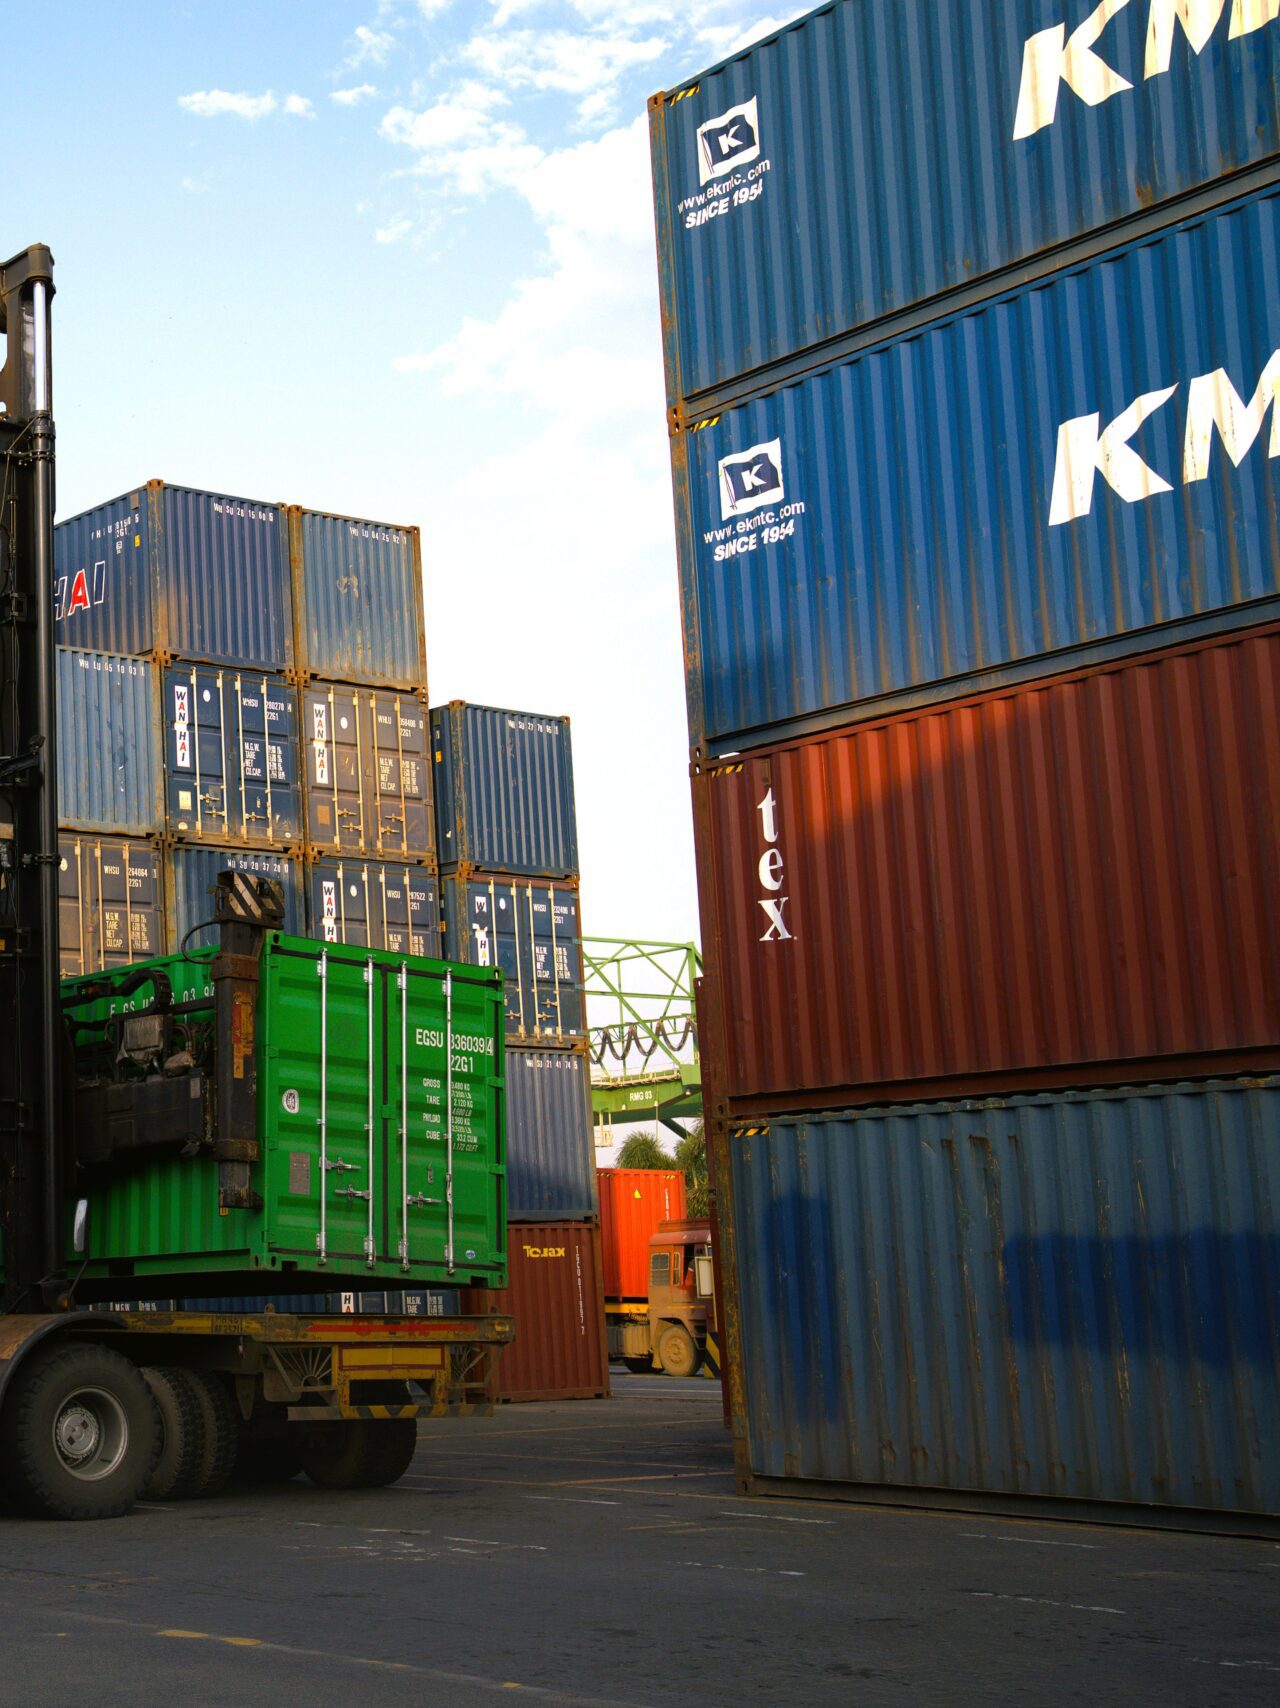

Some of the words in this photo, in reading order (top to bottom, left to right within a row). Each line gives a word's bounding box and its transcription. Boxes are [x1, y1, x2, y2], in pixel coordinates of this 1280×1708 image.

[718, 124, 743, 155] K
[685, 200, 729, 229] SINCE
[732, 178, 764, 209] 1954
[741, 463, 765, 489] K
[703, 500, 806, 544] www.ekmtc.com
[712, 533, 757, 562] SINCE
[760, 521, 795, 550] 1954
[176, 691, 187, 722] WAN
[314, 708, 325, 738] WAN
[178, 730, 187, 762] HAI
[104, 865, 120, 875] WHSU
[757, 787, 792, 942] tex
[323, 886, 334, 916] WAN
[327, 926, 335, 943] HA
[416, 1028, 444, 1048] EGSU
[451, 1055, 474, 1073] 22G1
[423, 1078, 440, 1088] GROSS
[426, 1095, 440, 1105] TARE
[466, 1100, 473, 1108] KG
[629, 1091, 644, 1102] RMG
[426, 1130, 440, 1140] CUBE
[343, 1294, 352, 1313] HA
